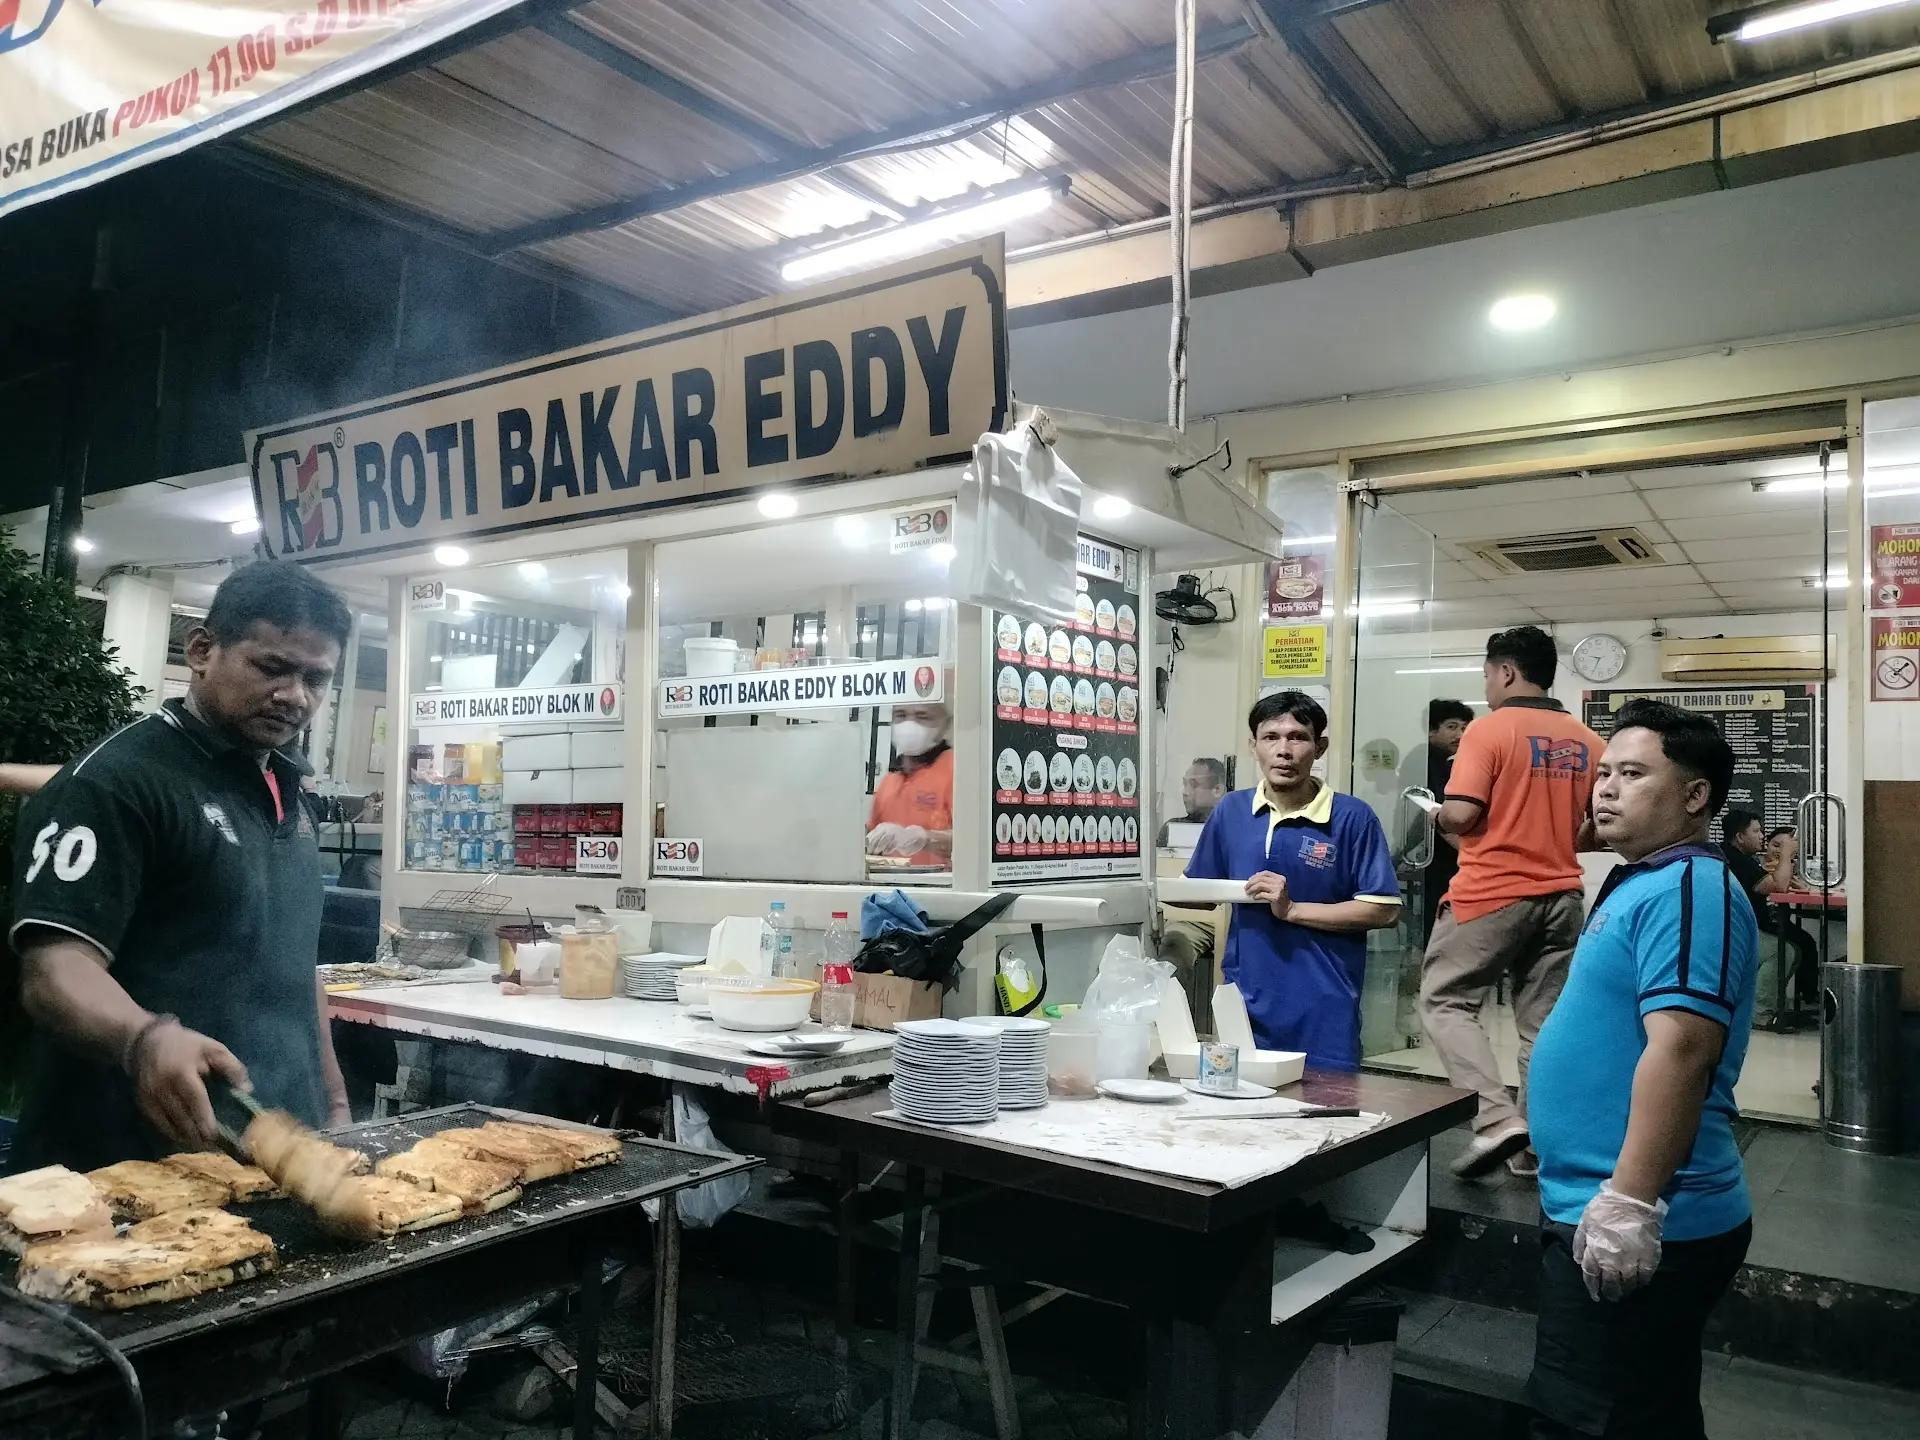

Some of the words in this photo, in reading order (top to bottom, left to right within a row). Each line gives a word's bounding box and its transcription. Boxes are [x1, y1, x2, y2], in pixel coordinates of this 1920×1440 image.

[0, 137, 33, 179] SA
[38, 107, 109, 166] BUKA
[112, 67, 201, 138] PUKUL
[206, 25, 277, 97] 17.00
[354, 418, 479, 535] ROTI
[497, 366, 719, 511] BAKAR
[743, 305, 967, 469] EDDY
[1092, 547, 1111, 571] EDDY
[1275, 637, 1314, 646] PERHATIAN
[699, 682, 732, 707] ROTI
[738, 678, 790, 704] BAKAR
[795, 675, 838, 700] EDDY
[842, 672, 887, 697] BLOK
[892, 670, 906, 695] M
[1683, 695, 1724, 707] BAKAR
[1726, 694, 1755, 706] EDDY
[440, 699, 466, 719] ROTI
[469, 698, 509, 718] BAKAR
[512, 695, 545, 716] EDDY
[547, 693, 580, 714] BLOK
[584, 692, 594, 712] M
